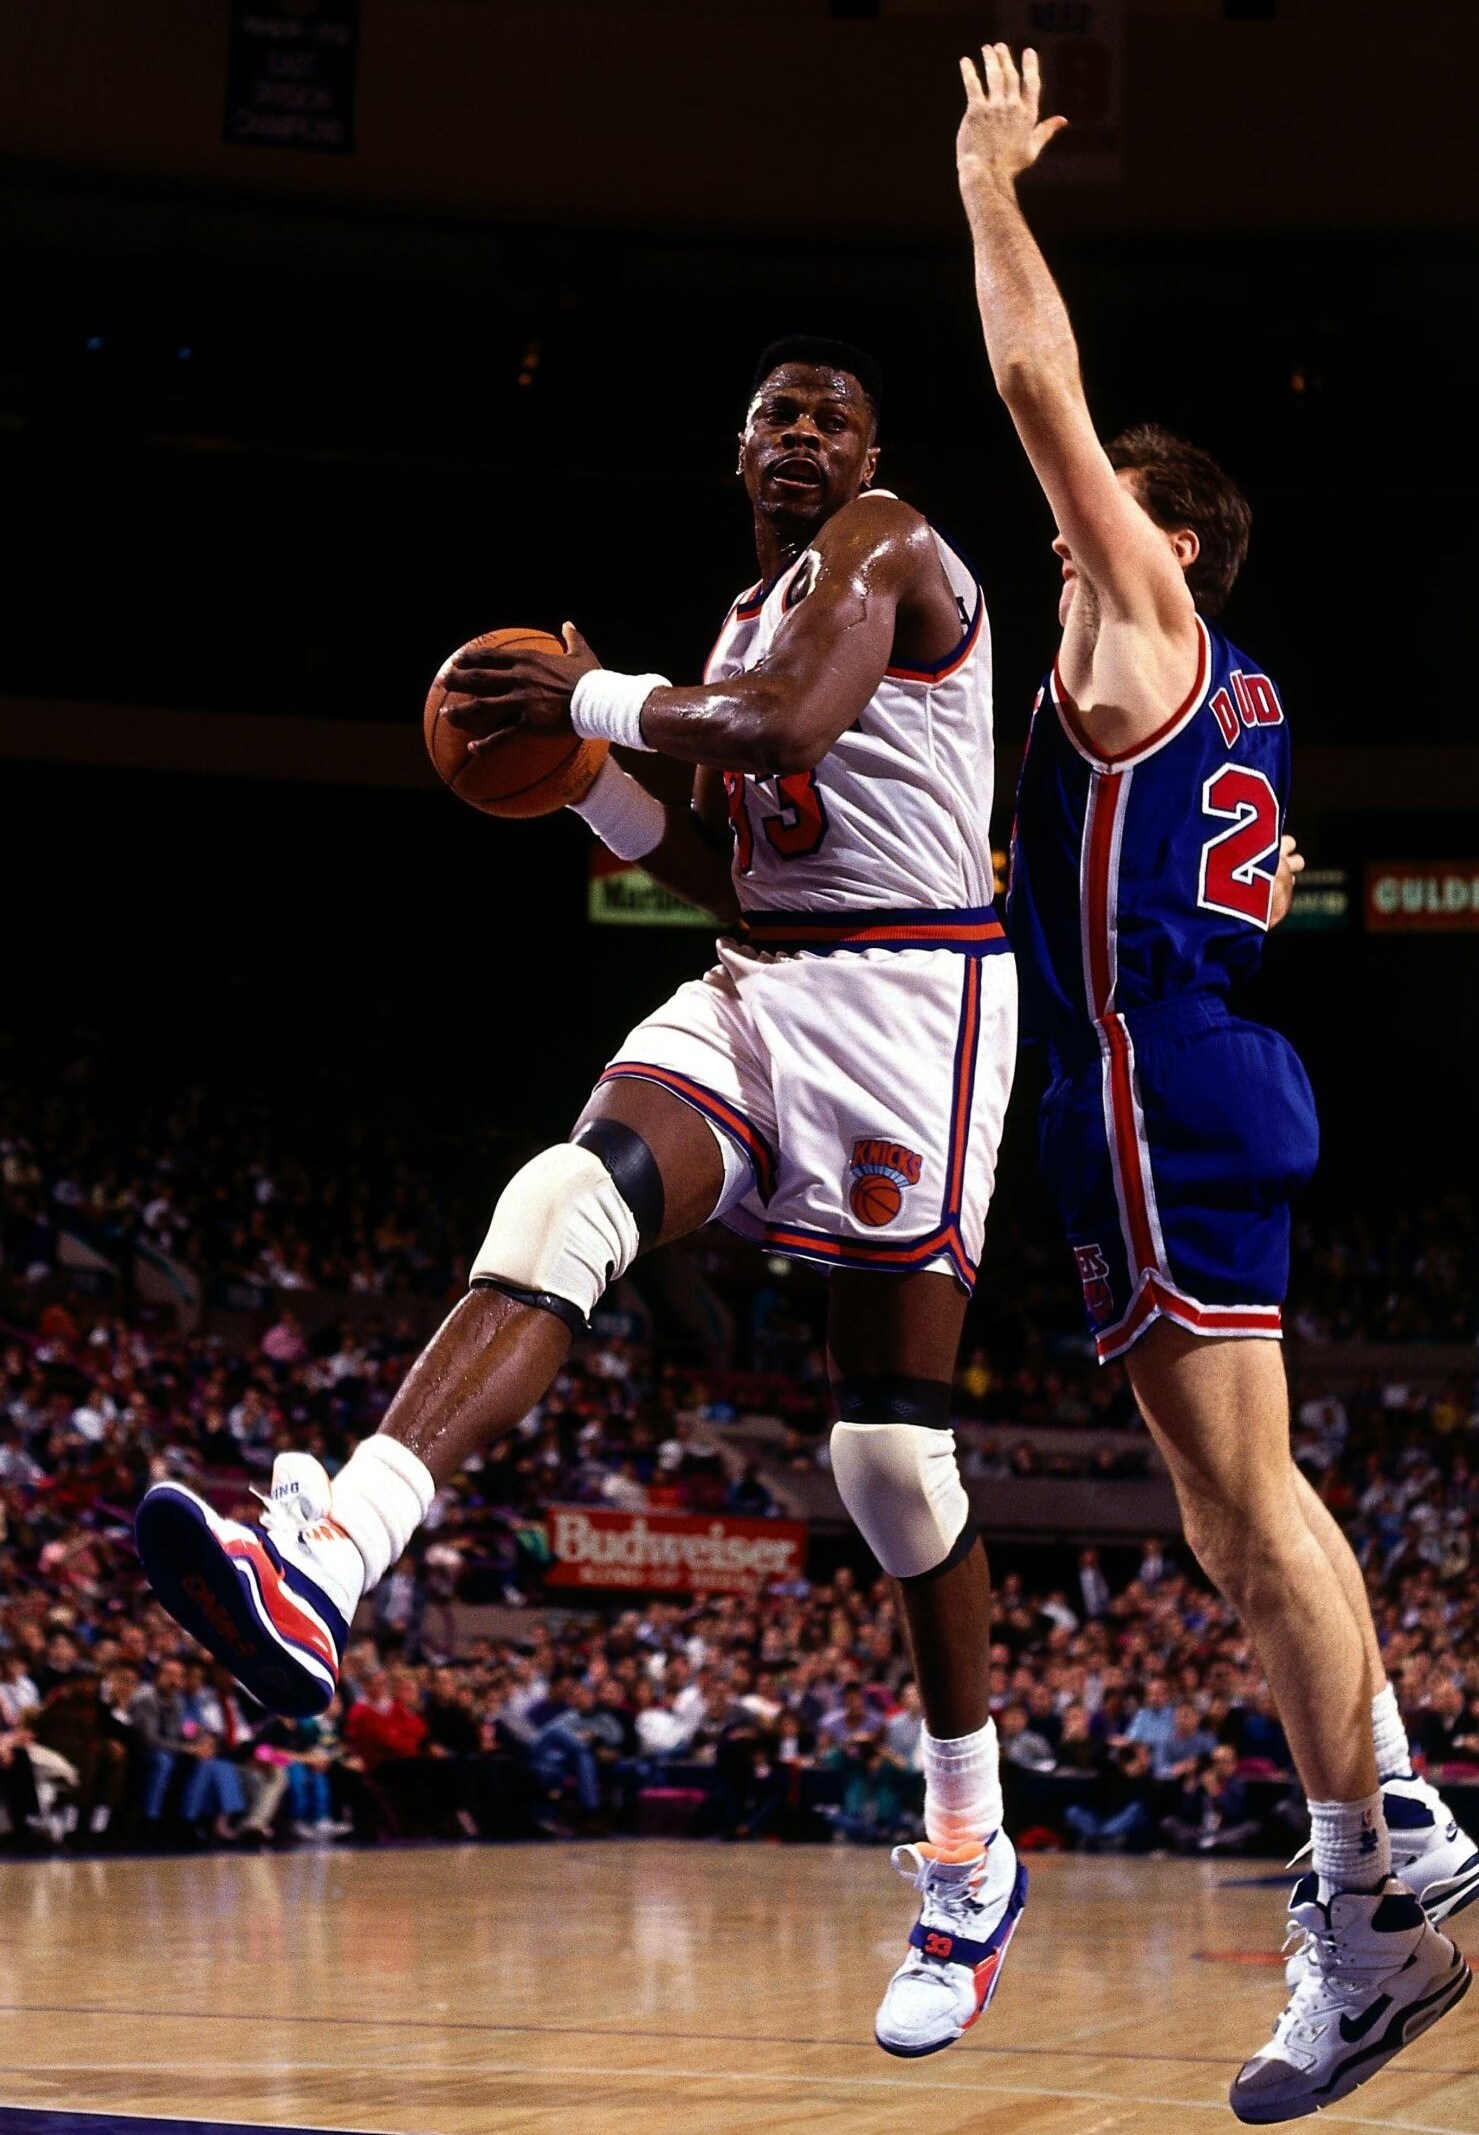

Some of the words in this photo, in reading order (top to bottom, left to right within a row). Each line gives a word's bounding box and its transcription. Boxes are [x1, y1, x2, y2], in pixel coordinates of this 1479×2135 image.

[851, 1140, 923, 1185] KNICKS
[554, 1512, 798, 1573] Budweiser
[924, 1933, 953, 1958] 33
